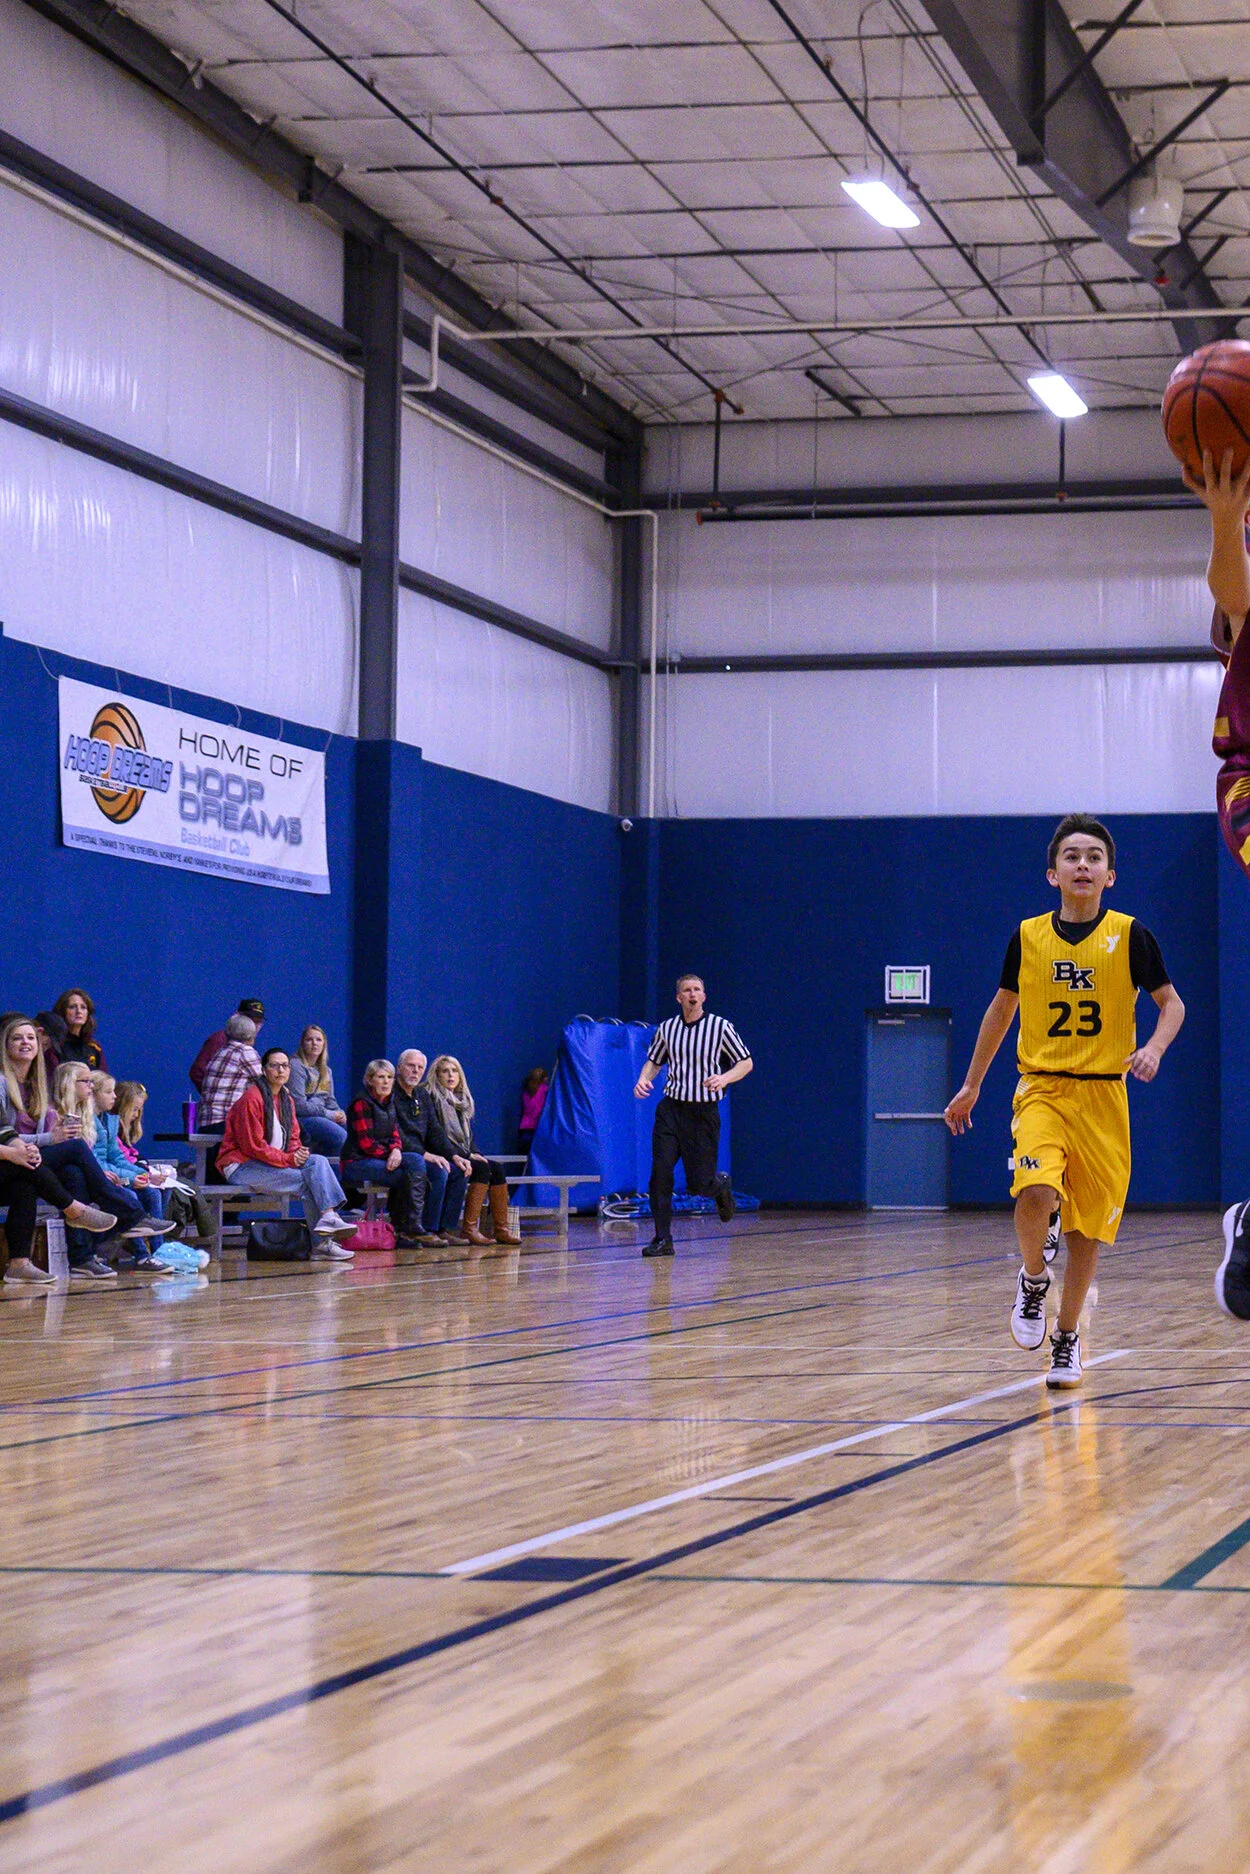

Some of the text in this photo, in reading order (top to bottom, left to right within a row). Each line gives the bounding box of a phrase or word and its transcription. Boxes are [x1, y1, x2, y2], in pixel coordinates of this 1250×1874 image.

[64, 734, 111, 777] HOOP
[178, 728, 304, 779] HOME OF
[178, 761, 265, 806] HOOP
[178, 789, 303, 846] DREAMS
[180, 827, 251, 858] Basketball Club
[1053, 960, 1095, 991] BK
[1047, 1000, 1103, 1038] 23
